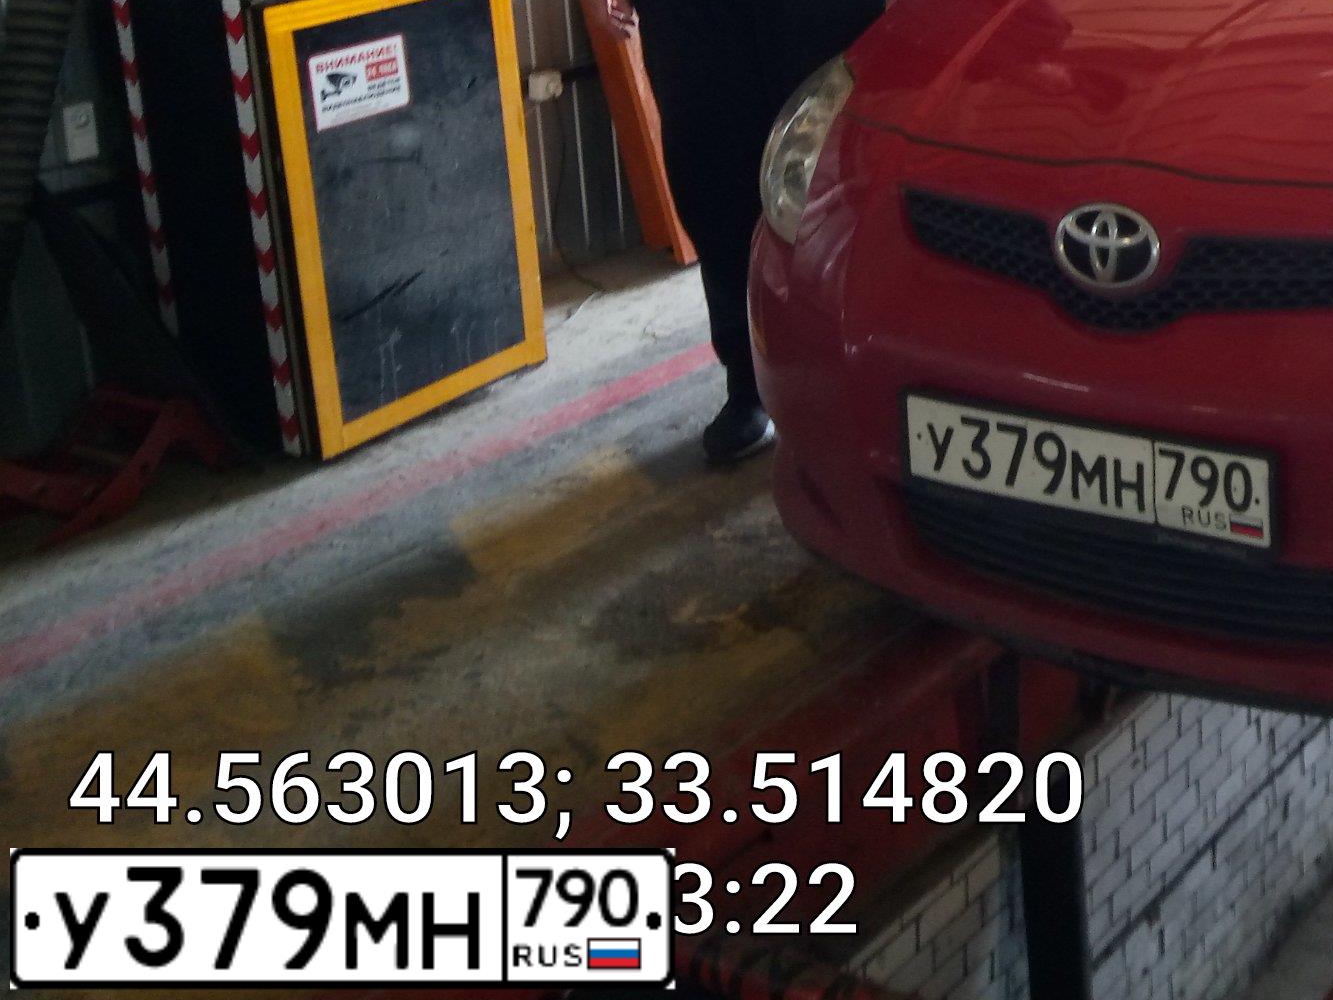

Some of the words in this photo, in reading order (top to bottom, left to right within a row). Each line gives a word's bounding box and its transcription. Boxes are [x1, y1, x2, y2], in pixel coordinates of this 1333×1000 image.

[927, 415, 1145, 513] У379МН
[1157, 448, 1253, 513] 790
[1181, 505, 1227, 532] RUS
